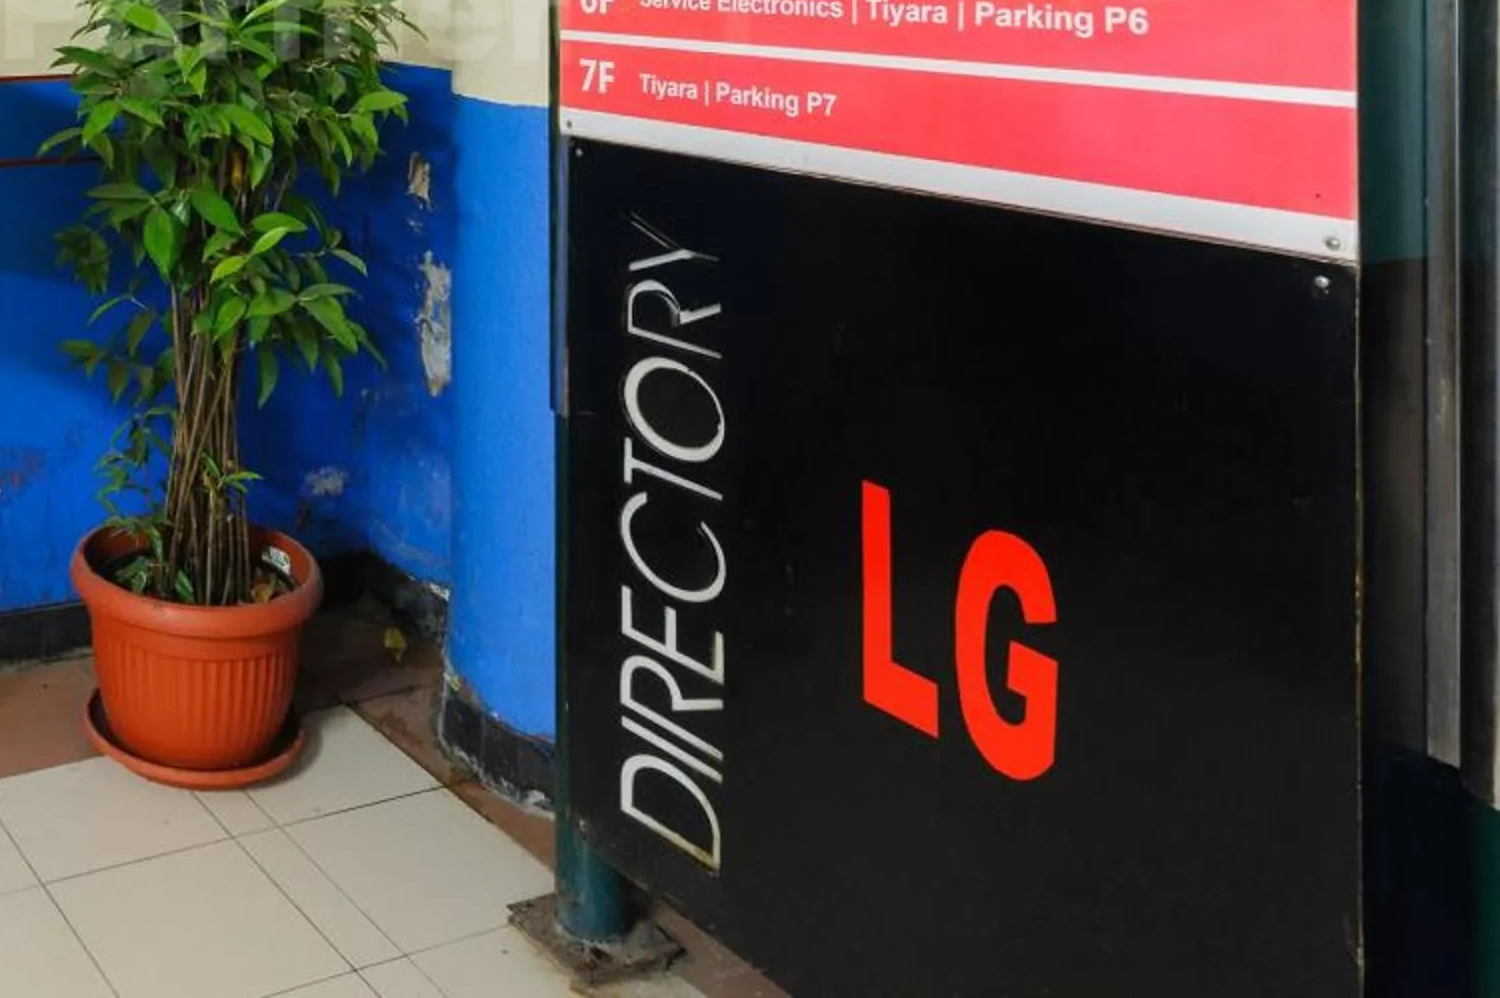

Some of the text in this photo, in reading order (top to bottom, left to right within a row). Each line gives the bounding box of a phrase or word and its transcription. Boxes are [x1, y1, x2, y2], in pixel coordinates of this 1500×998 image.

[579, 58, 837, 117] 7F Tiyara Parking P7
[975, 1, 1094, 39] Parking
[1105, 6, 1149, 36] P6
[619, 212, 726, 872] DIRECTORY
[861, 479, 1059, 782] LG
